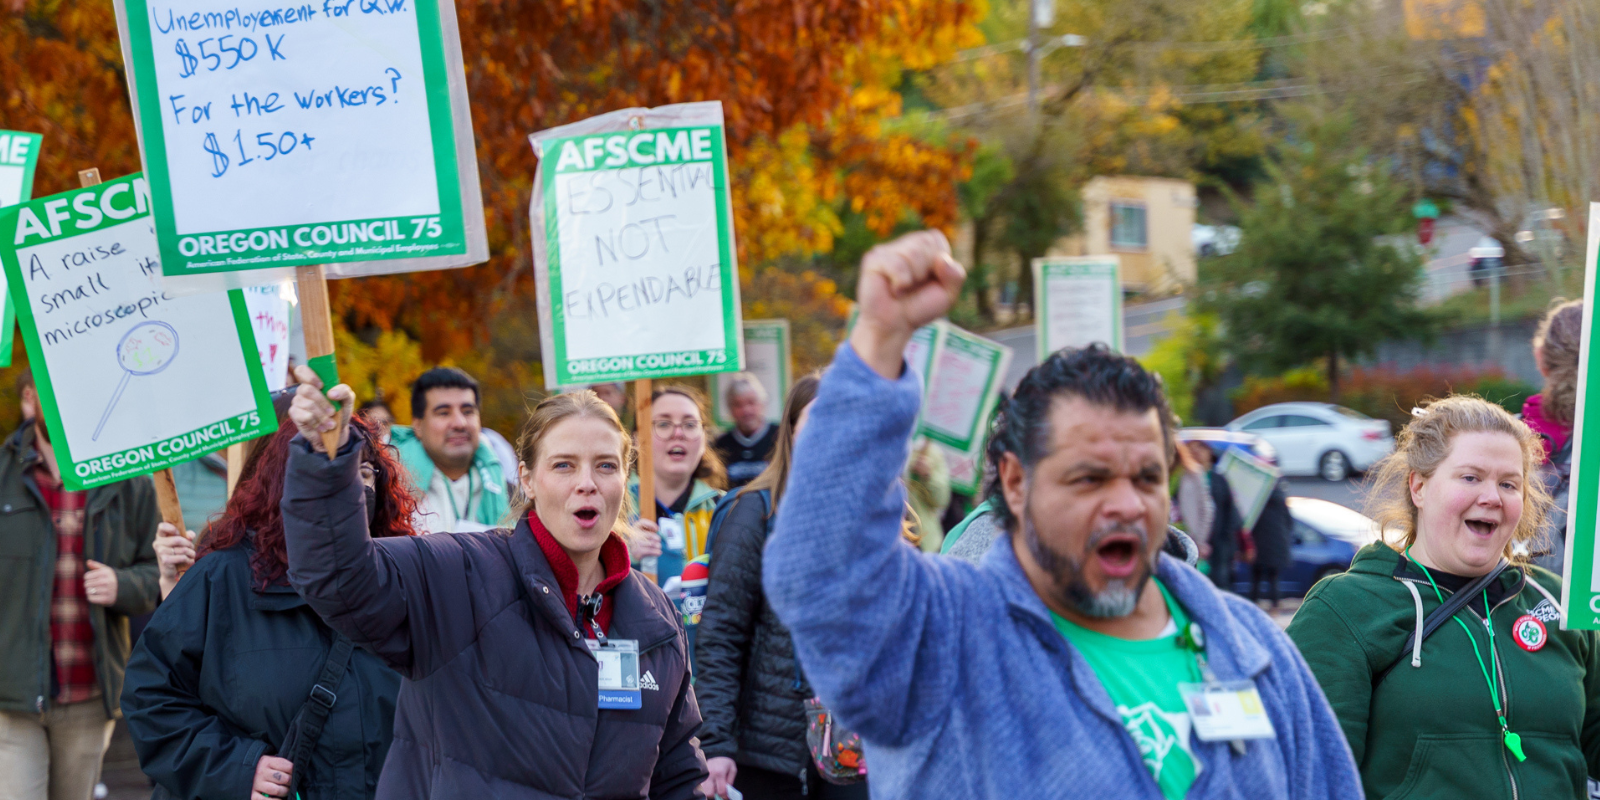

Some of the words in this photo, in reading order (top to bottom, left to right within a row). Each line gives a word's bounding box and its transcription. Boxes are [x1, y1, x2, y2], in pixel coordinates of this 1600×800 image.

[175, 34, 258, 78] $550
[169, 94, 212, 125] For
[230, 92, 285, 117] the
[555, 129, 713, 172] AFSCME
[178, 228, 289, 257] OREGON
[293, 219, 406, 247] COUNCIL
[410, 217, 443, 239] 75
[186, 259, 226, 269] American
[227, 256, 272, 265] Federation
[272, 253, 282, 262] of
[307, 249, 337, 259] County
[337, 247, 354, 256] and
[355, 244, 395, 256] Municipal
[396, 243, 440, 253] Employees
[595, 214, 677, 266] NOT
[30, 253, 51, 281] A
[61, 242, 127, 270] raise
[41, 272, 110, 314] small
[566, 263, 723, 320] EXPENDABLE
[567, 356, 634, 375] OREGON
[635, 351, 704, 369] COUNCIL
[706, 349, 727, 364] 75
[75, 446, 154, 478] OREGON
[156, 420, 236, 457] COUNCIL
[237, 411, 261, 430] 75
[598, 694, 633, 703] Pharmacist
[639, 682, 660, 691] adidas
